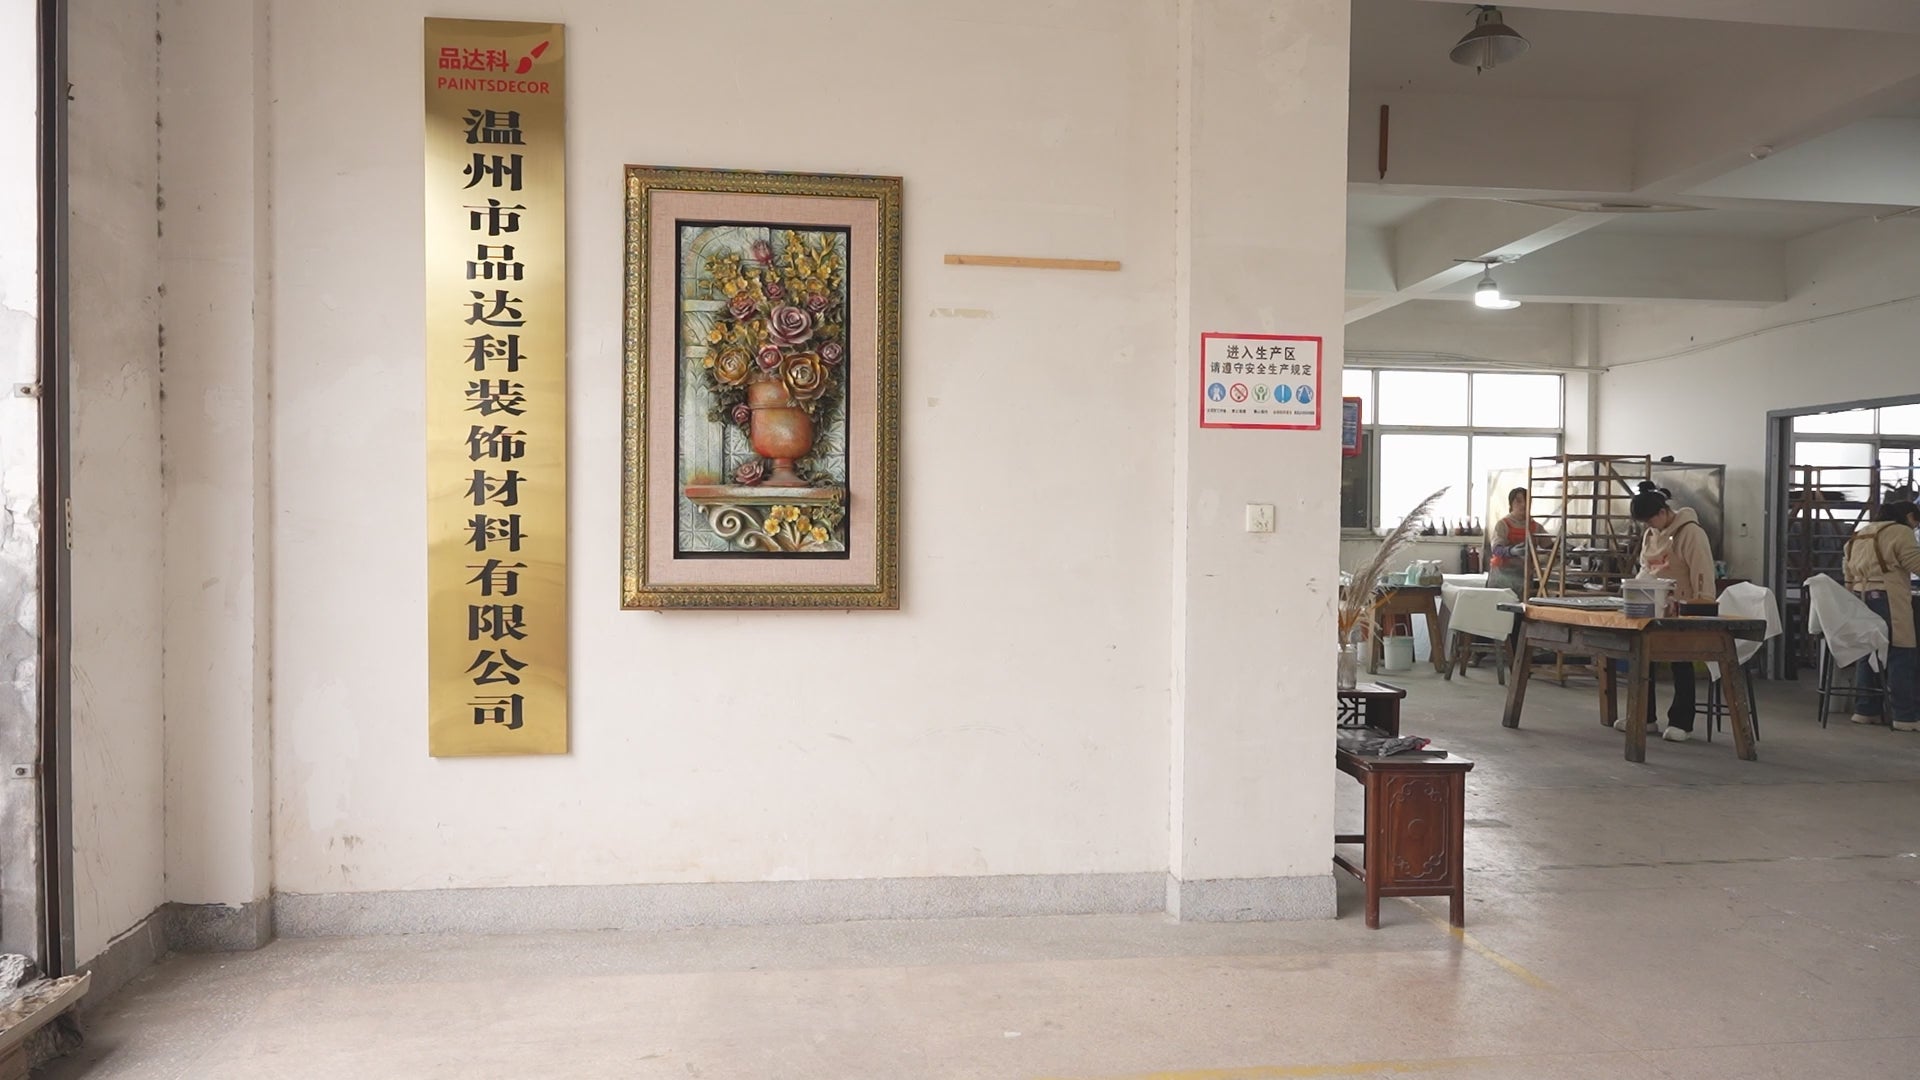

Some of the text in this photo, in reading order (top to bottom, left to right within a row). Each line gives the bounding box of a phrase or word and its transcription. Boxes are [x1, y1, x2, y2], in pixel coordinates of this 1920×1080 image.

[439, 47, 509, 72] 品达科
[437, 77, 550, 94] PAINTSDECOR
[1227, 345, 1296, 360] 进入生产区
[1210, 362, 1312, 376] 请遵守安全生产规定
[461, 108, 528, 731] 温州市品达科装饰材料有限公司
